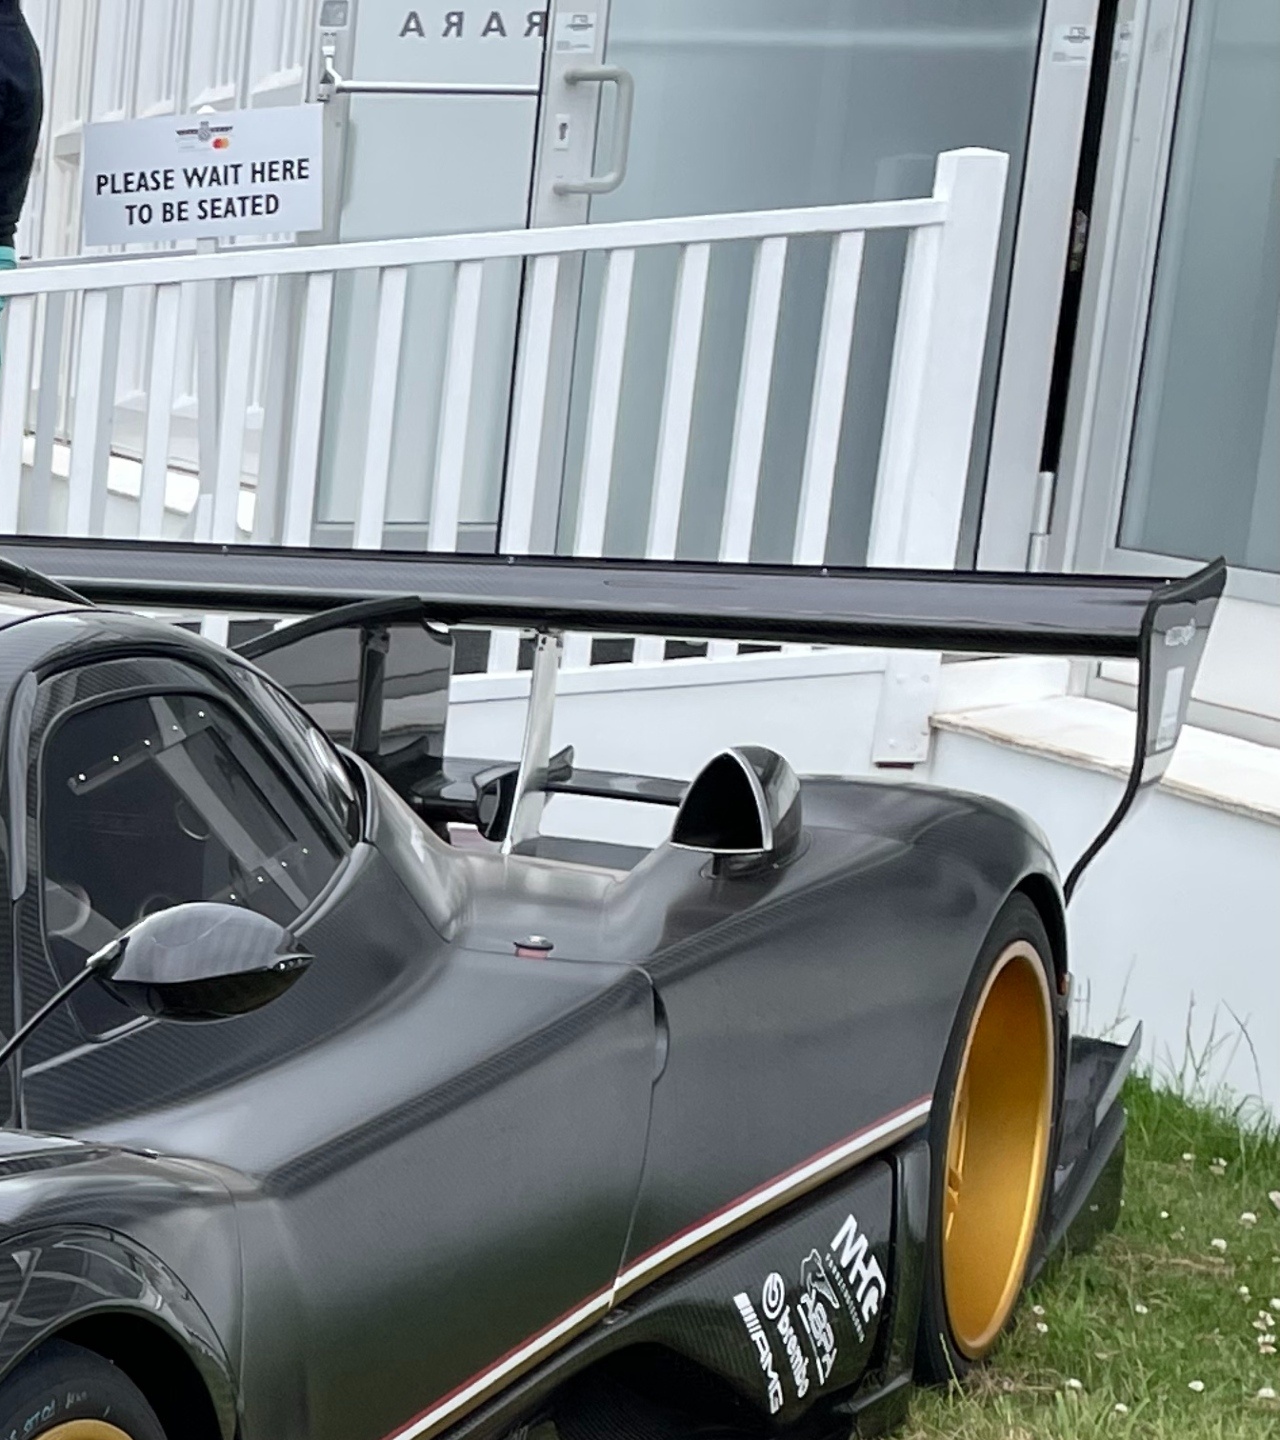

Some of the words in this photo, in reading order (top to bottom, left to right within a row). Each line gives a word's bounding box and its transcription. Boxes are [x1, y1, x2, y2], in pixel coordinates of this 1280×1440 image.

[96, 169, 175, 195] PLEASE
[183, 163, 243, 188] WAIT
[251, 158, 310, 184] HERE
[125, 203, 153, 225] TO
[162, 200, 189, 223] BE
[197, 194, 279, 220] SEATED
[776, 1305, 810, 1398] brembo
